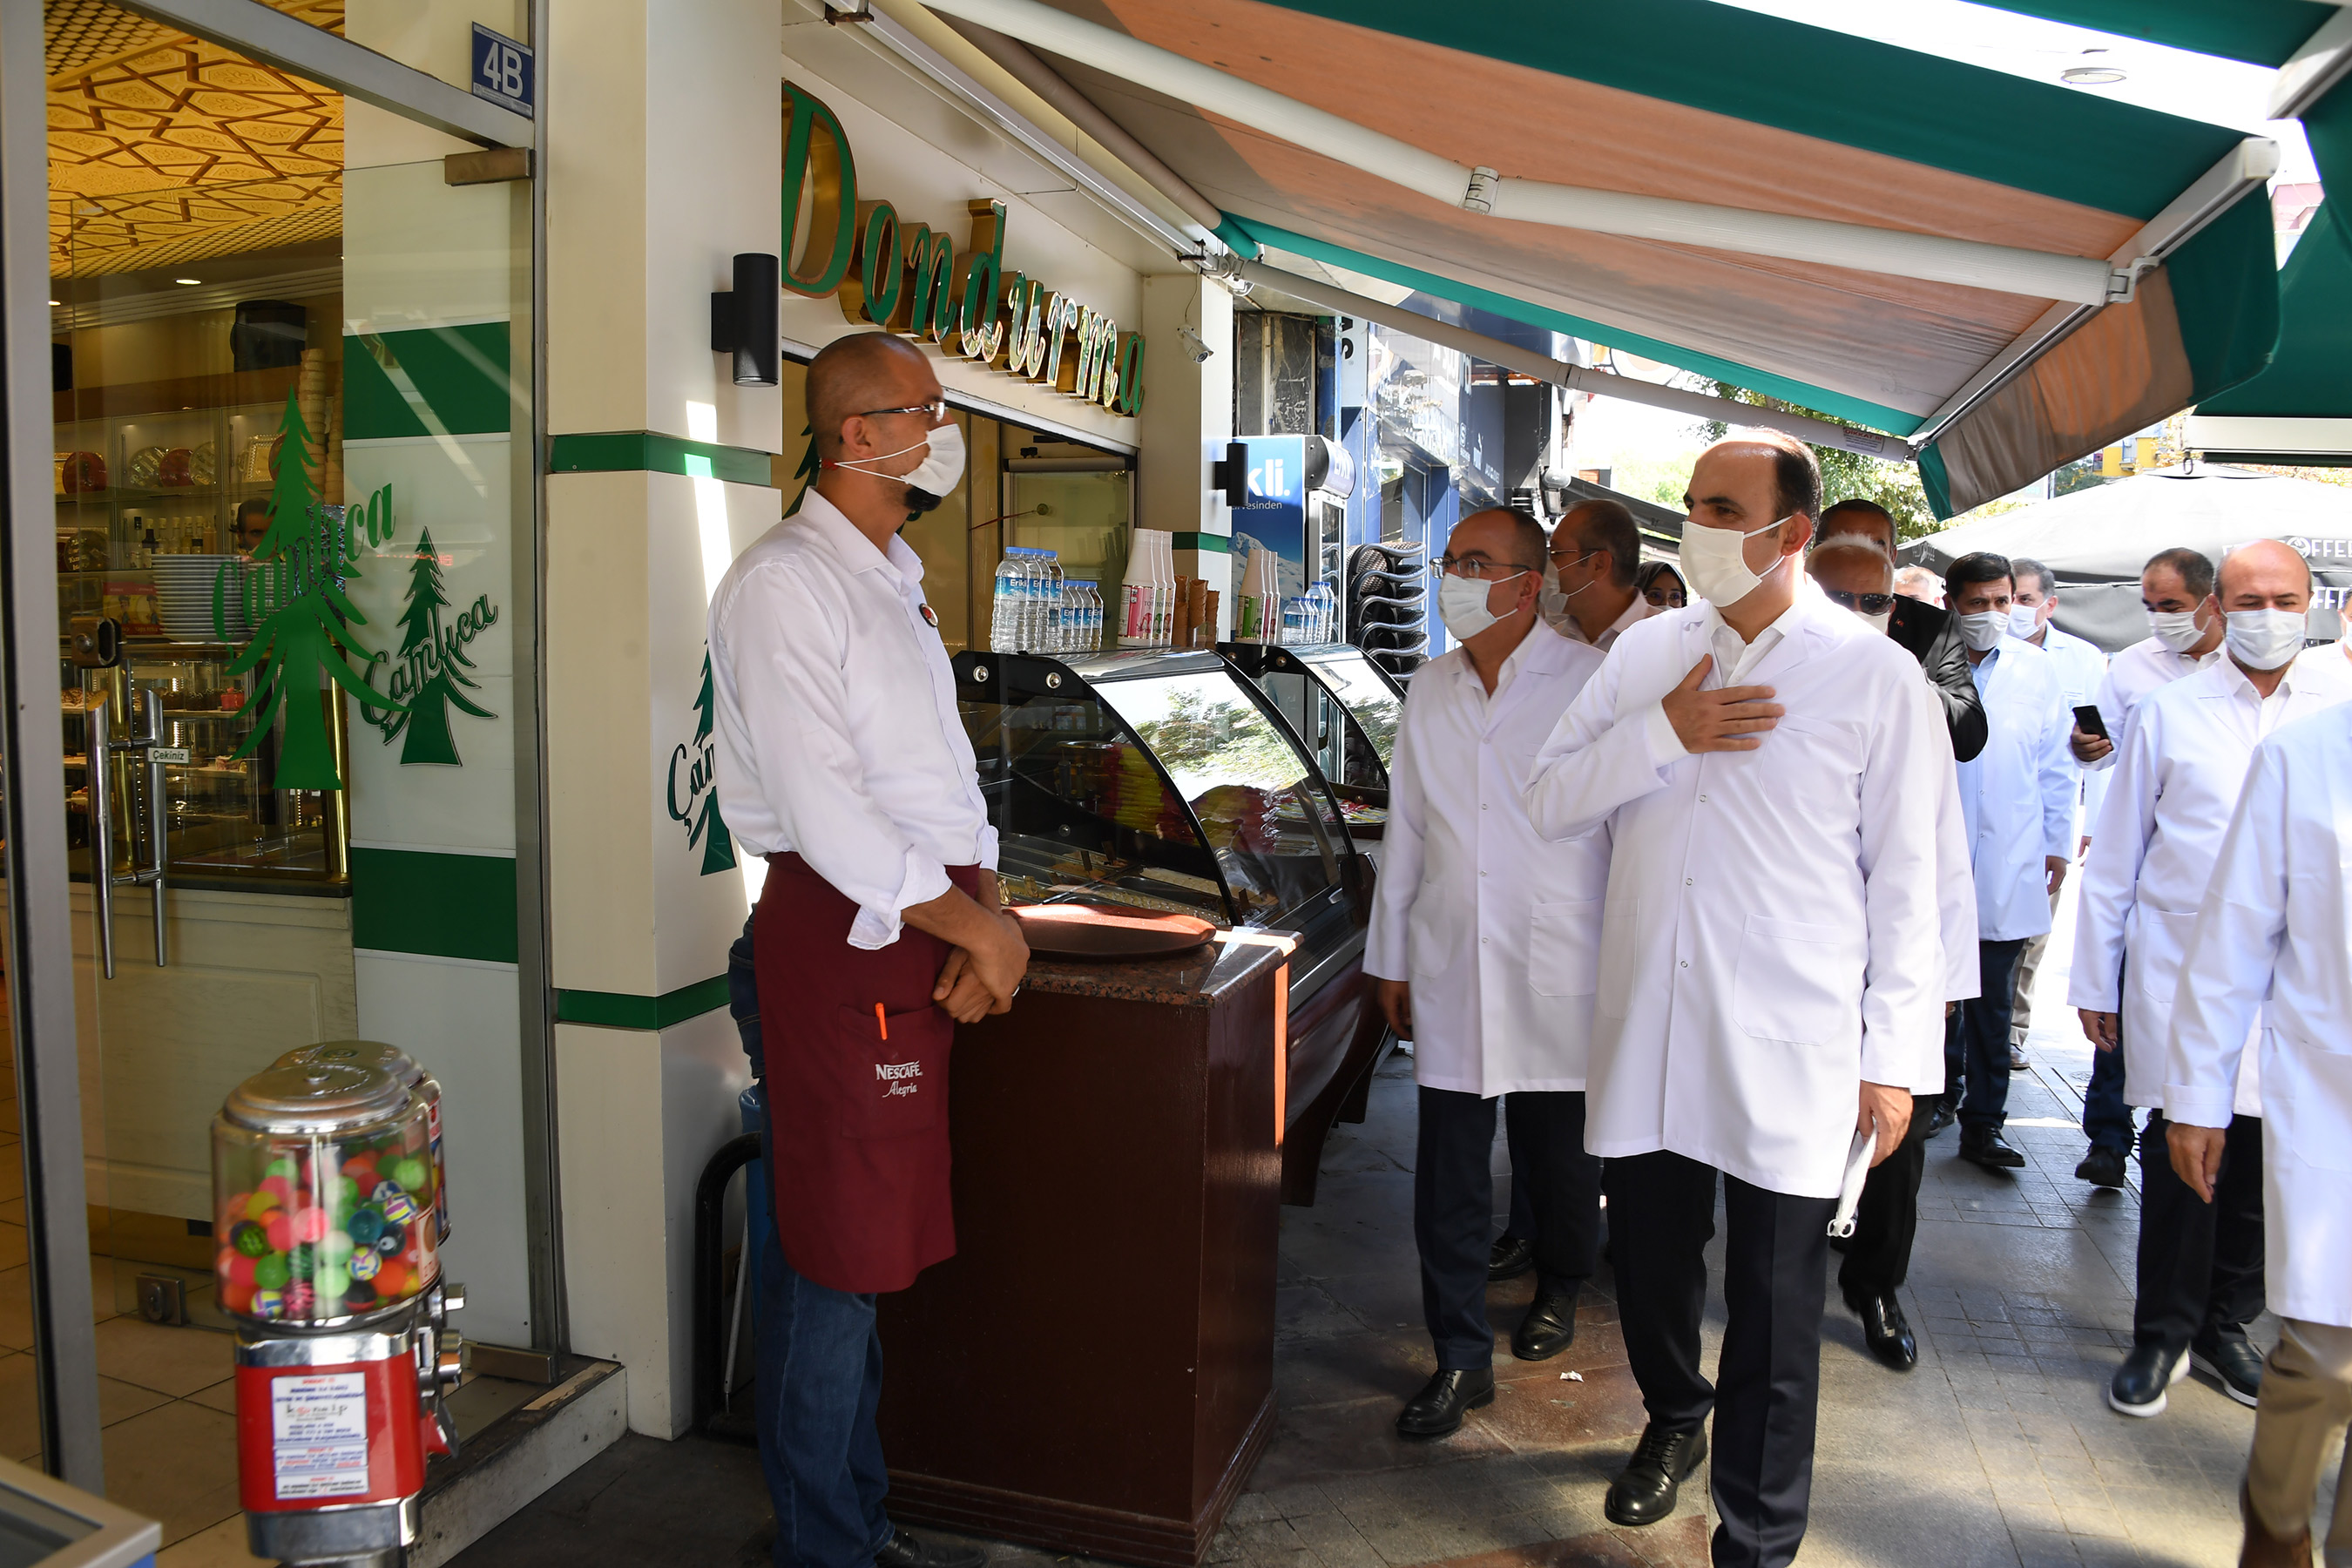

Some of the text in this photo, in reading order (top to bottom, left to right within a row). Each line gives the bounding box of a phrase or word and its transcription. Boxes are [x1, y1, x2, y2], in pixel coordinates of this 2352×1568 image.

[483, 41, 524, 98] 4B
[781, 78, 1145, 418] Dondurma
[1247, 458, 1290, 497] kli.
[360, 593, 498, 744] Çamlıca
[152, 750, 185, 762] Çekiniz
[875, 1060, 921, 1080] NESCAFÉ
[882, 1081, 917, 1098] Alegria
